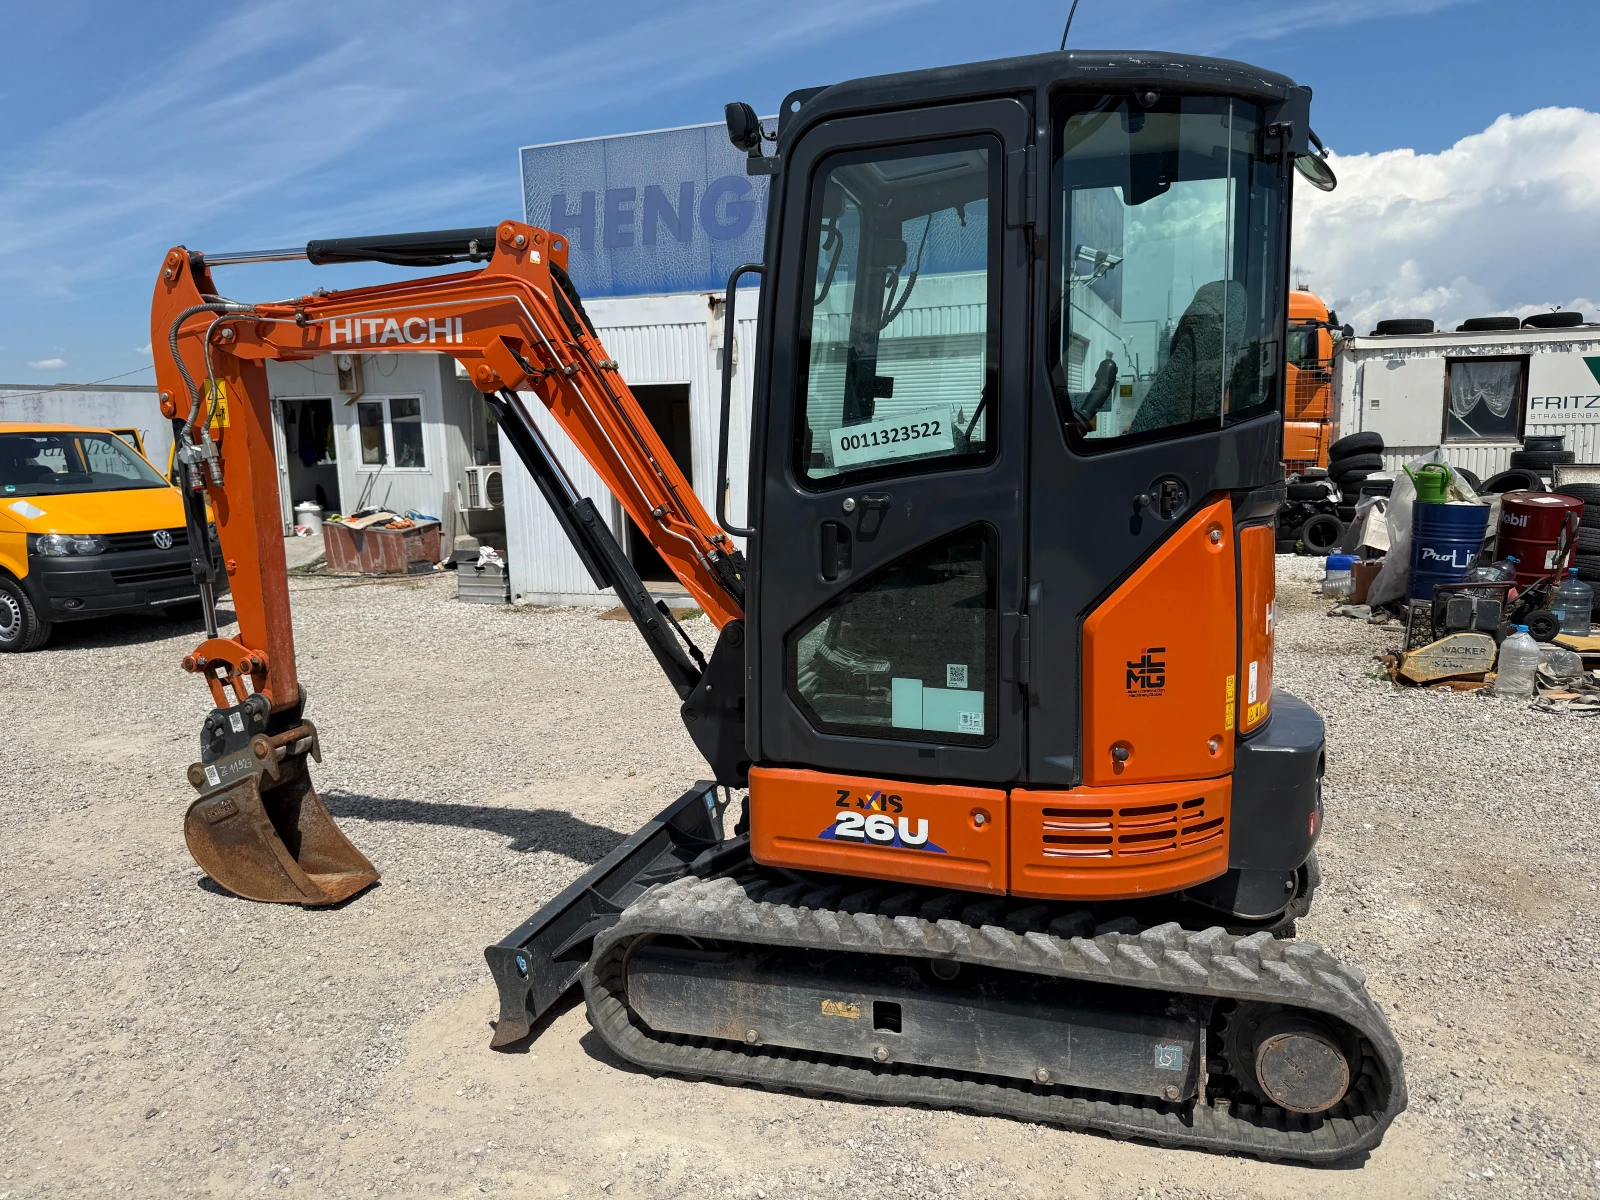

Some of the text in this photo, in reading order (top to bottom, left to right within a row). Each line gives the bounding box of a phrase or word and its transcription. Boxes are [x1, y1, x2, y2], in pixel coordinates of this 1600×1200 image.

[551, 175, 769, 250] HENG
[329, 317, 463, 344] HITACHI
[1531, 395, 1600, 409] FRITZ
[840, 420, 942, 451] 0011323522
[1441, 645, 1487, 655] WACKER
[835, 811, 929, 848] 26U
